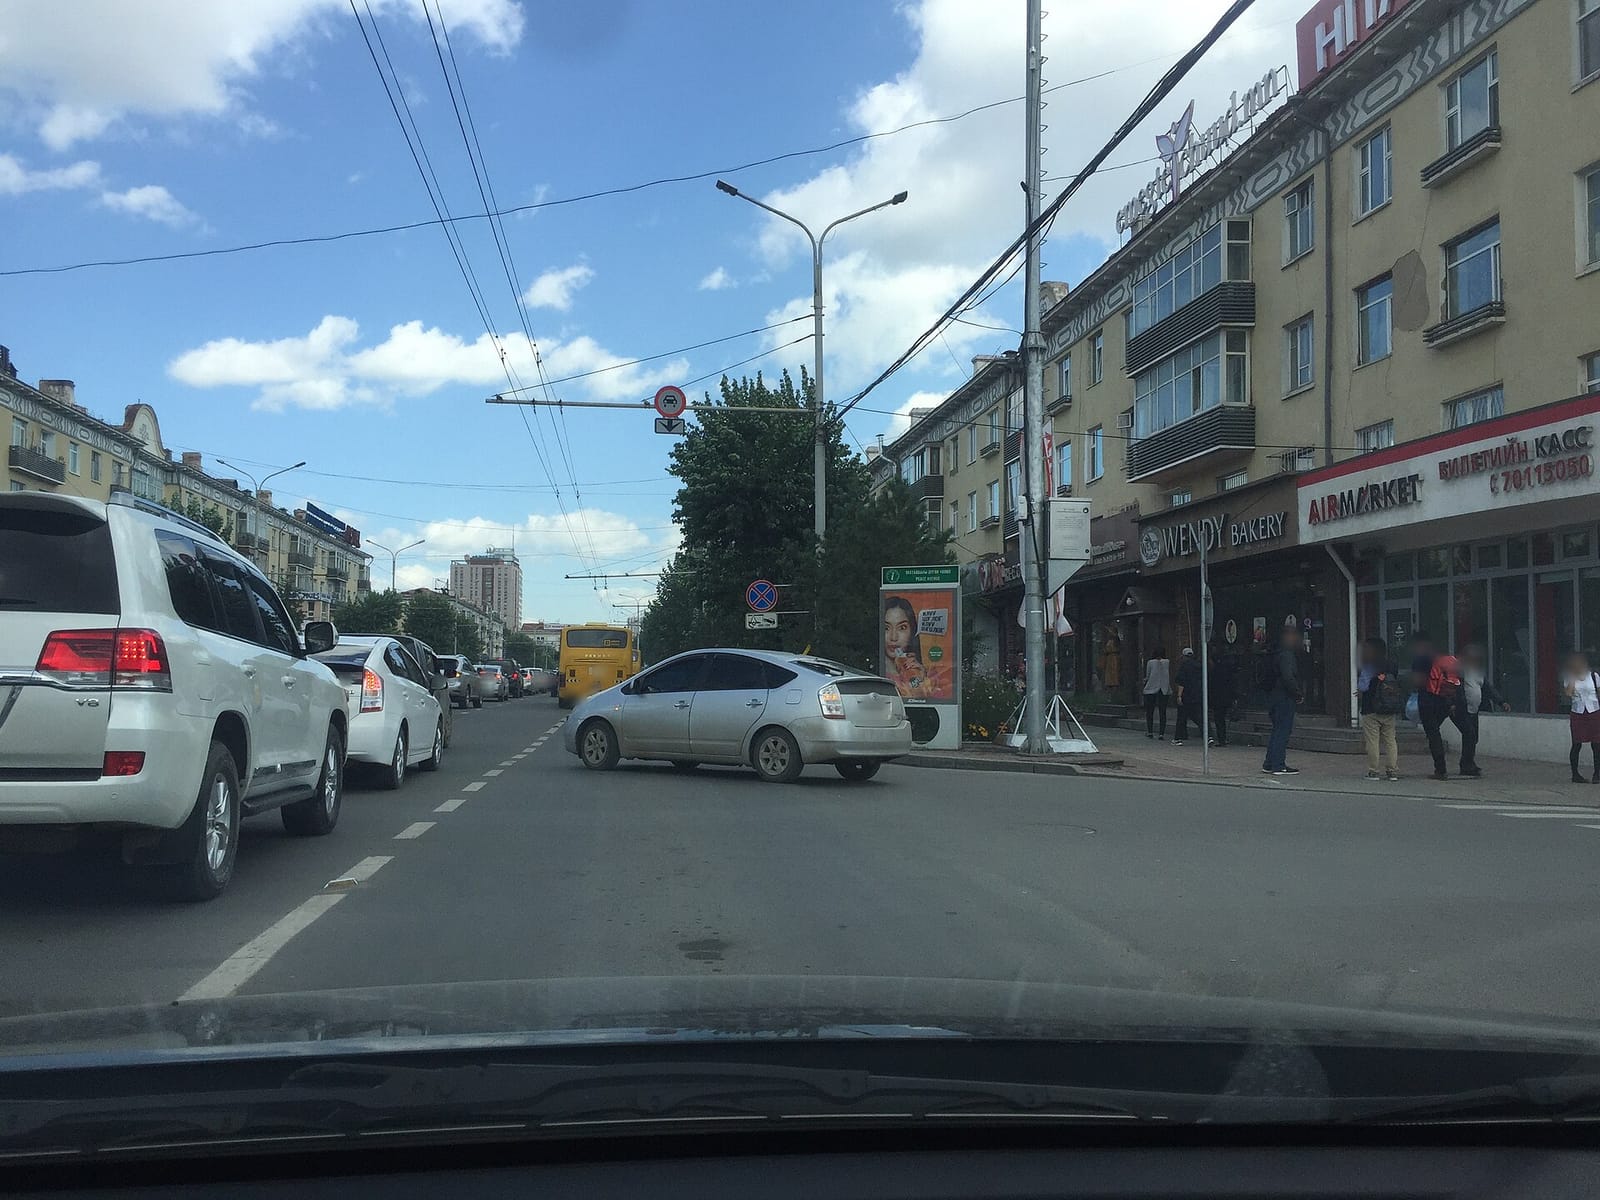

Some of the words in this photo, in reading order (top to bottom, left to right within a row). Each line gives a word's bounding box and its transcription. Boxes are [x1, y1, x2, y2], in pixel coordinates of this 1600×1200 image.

[1438, 437, 1530, 481] БИЛЕТИЙН
[1534, 426, 1594, 459] КАСС
[1501, 453, 1595, 493] 70115050
[1308, 473, 1422, 525] AIRMARKET
[1162, 513, 1226, 558] WENDY
[1231, 511, 1287, 547] BAKERY
[75, 698, 99, 708] V8
